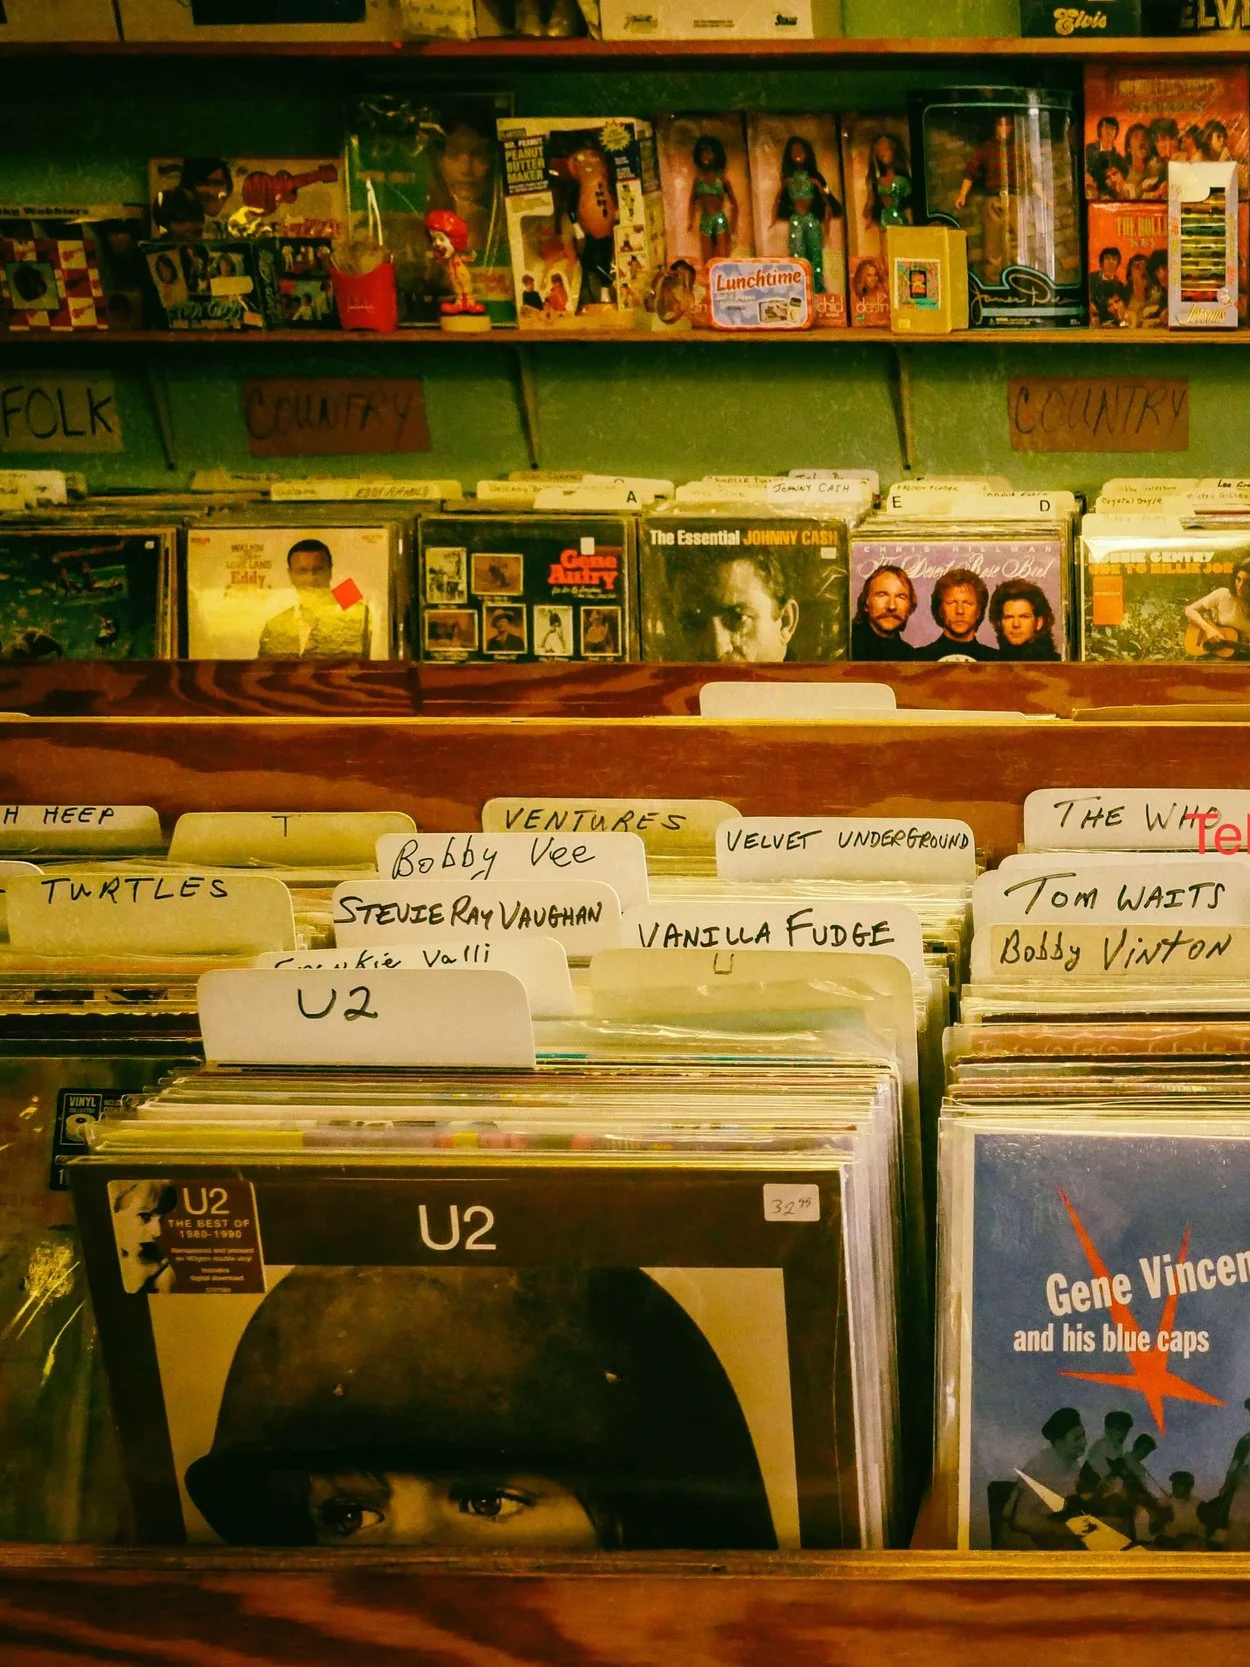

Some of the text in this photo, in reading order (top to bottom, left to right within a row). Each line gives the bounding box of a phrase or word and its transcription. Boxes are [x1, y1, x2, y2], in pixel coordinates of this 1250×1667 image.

[1053, 8, 1107, 35] Elvis
[505, 146, 544, 160] PEANUT
[506, 158, 545, 172] BUTTER
[507, 170, 543, 183] MAKER
[717, 269, 802, 292] Lunchtime
[1, 384, 113, 439] FOLK
[246, 384, 418, 441] COUNTRY
[1014, 385, 1188, 436] COUNTRY
[627, 490, 638, 503] A
[773, 483, 851, 494] JOHNNY CASH
[1217, 479, 1232, 489] Lee
[893, 495, 903, 509] E
[1040, 500, 1051, 513] D
[1101, 497, 1135, 506] Crystal
[650, 529, 840, 547] The Essential JOHNNY CASH
[560, 549, 617, 569] Gene
[1125, 564, 1147, 574] TO
[1150, 563, 1201, 574] BILLIE
[1203, 562, 1234, 574] JOE
[1150, 551, 1215, 563] GENTRY
[231, 571, 266, 588] Eddy
[547, 563, 618, 591] Autry
[43, 806, 116, 825] HEEP
[504, 807, 688, 834] VENTURES
[1053, 796, 1123, 829] THE
[271, 814, 302, 838] T
[726, 826, 971, 854] VELVET UNDERGROUND
[391, 835, 598, 882] Bobby Vee
[40, 875, 230, 904] TURTLES
[1004, 871, 1227, 917] TOM WAITS
[332, 895, 605, 930] STEVIE RAY VAUGHAN
[638, 907, 897, 949] VANILLA FUDGE
[422, 941, 492, 968] Valli
[999, 927, 1084, 973] Bobby
[297, 985, 379, 1021] U2
[69, 1096, 97, 1107] VINYL
[182, 1186, 230, 1215] U2
[168, 1219, 250, 1228] THE BEST OF
[180, 1229, 243, 1239] 1980-1990
[417, 1204, 498, 1252] U2
[1044, 1268, 1133, 1319] Gene
[1013, 1322, 1211, 1360] and his blue caps
